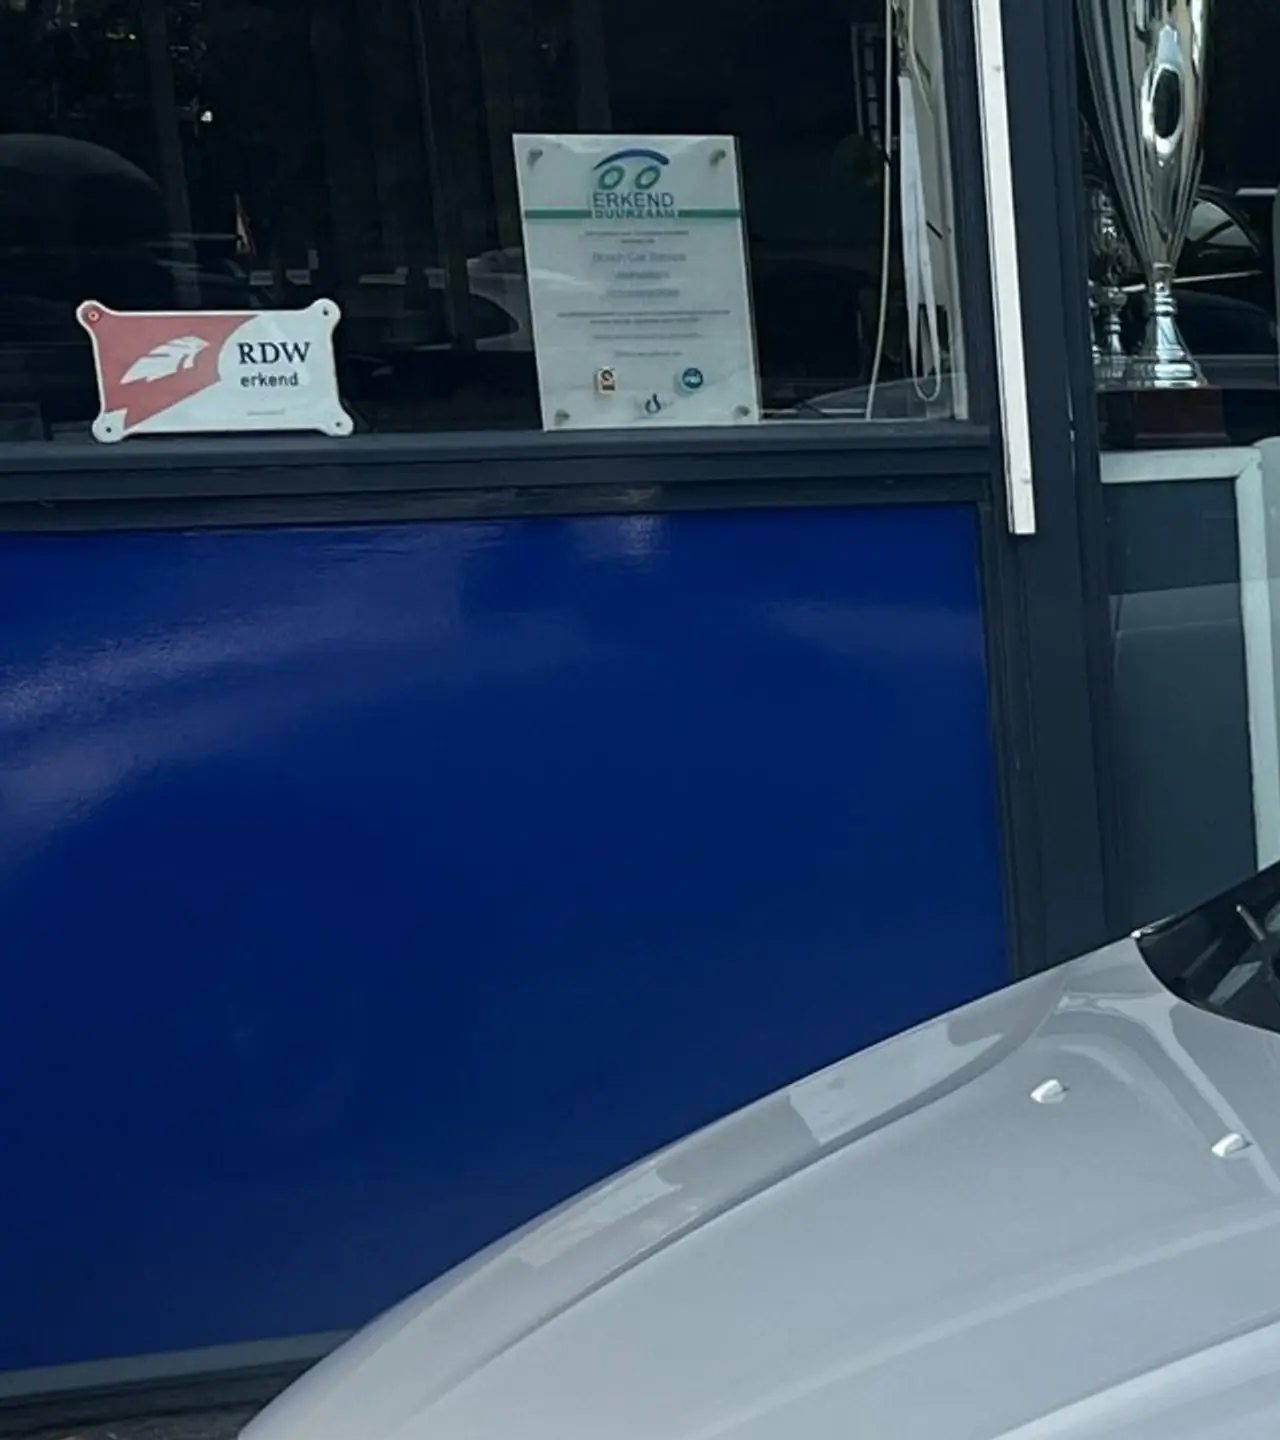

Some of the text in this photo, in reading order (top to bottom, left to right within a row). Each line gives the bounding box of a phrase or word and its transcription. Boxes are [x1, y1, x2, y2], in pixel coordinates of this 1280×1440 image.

[593, 191, 675, 208] ERKEND
[237, 341, 311, 366] RDW
[240, 371, 299, 388] erkend
